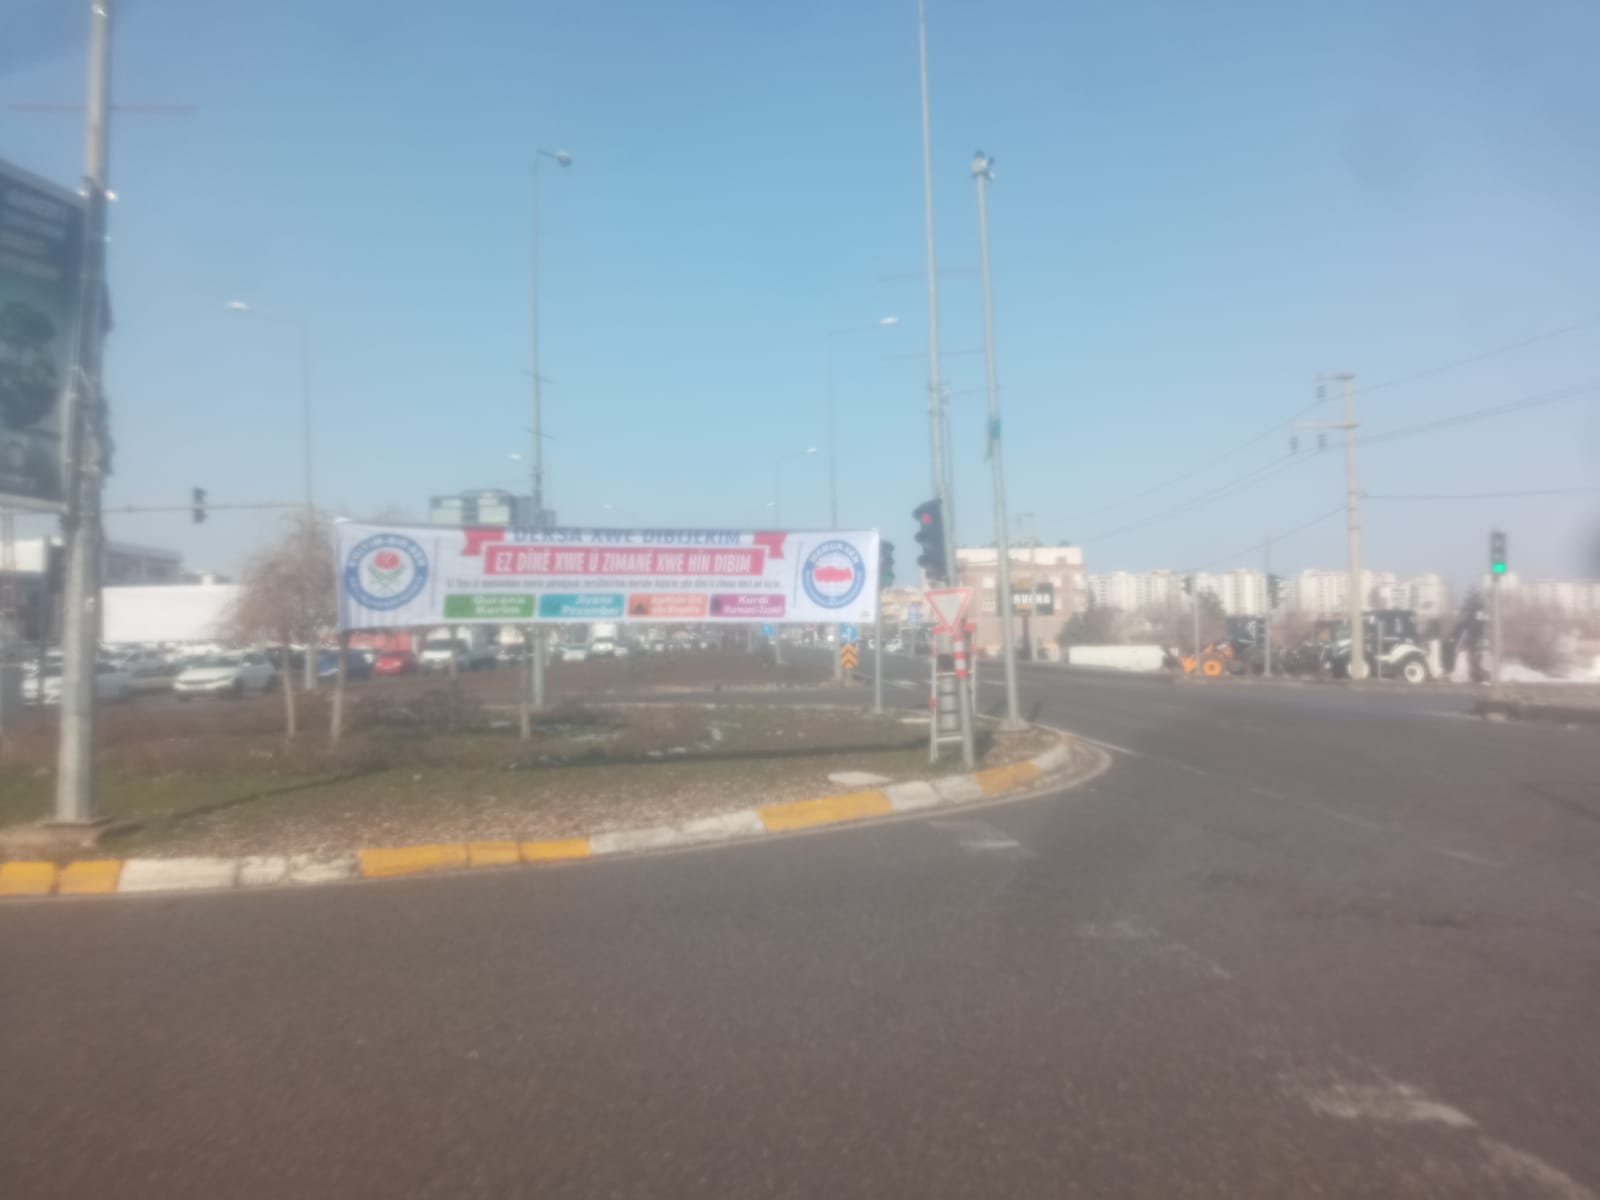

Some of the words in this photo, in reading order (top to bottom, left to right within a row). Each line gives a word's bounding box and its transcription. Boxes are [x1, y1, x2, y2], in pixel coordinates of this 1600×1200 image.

[495, 551, 513, 572] EZ
[553, 551, 586, 573] XWE
[655, 552, 685, 573] XWE
